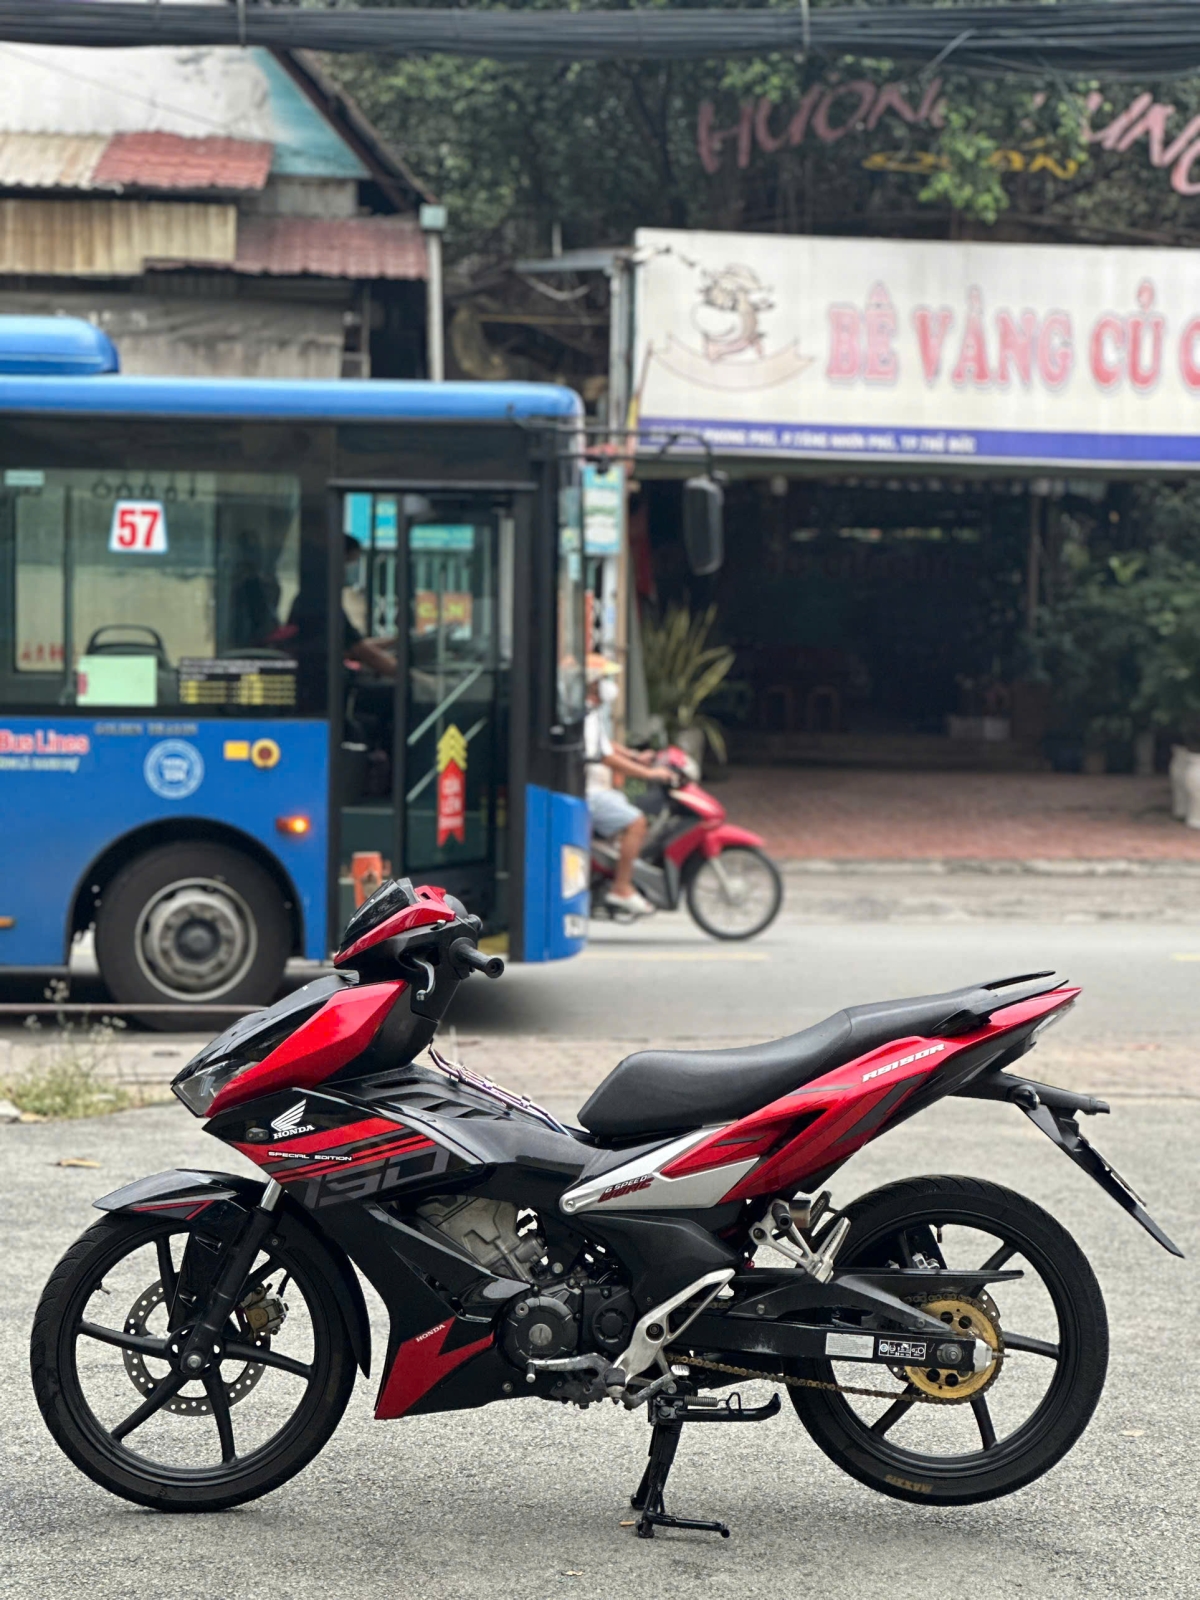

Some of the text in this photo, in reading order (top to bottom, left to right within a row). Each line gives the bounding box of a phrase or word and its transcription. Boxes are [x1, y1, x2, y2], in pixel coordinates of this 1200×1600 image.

[827, 280, 899, 386] BÊ
[1088, 278, 1166, 389] CỦ
[118, 509, 159, 548] 57
[862, 1043, 945, 1083] RS150R
[273, 1124, 315, 1140] HONDA
[268, 1151, 310, 1160] SPECIAL
[300, 1145, 450, 1209] 150
[614, 1175, 648, 1191] SPEED
[415, 1324, 445, 1342] HONDA
